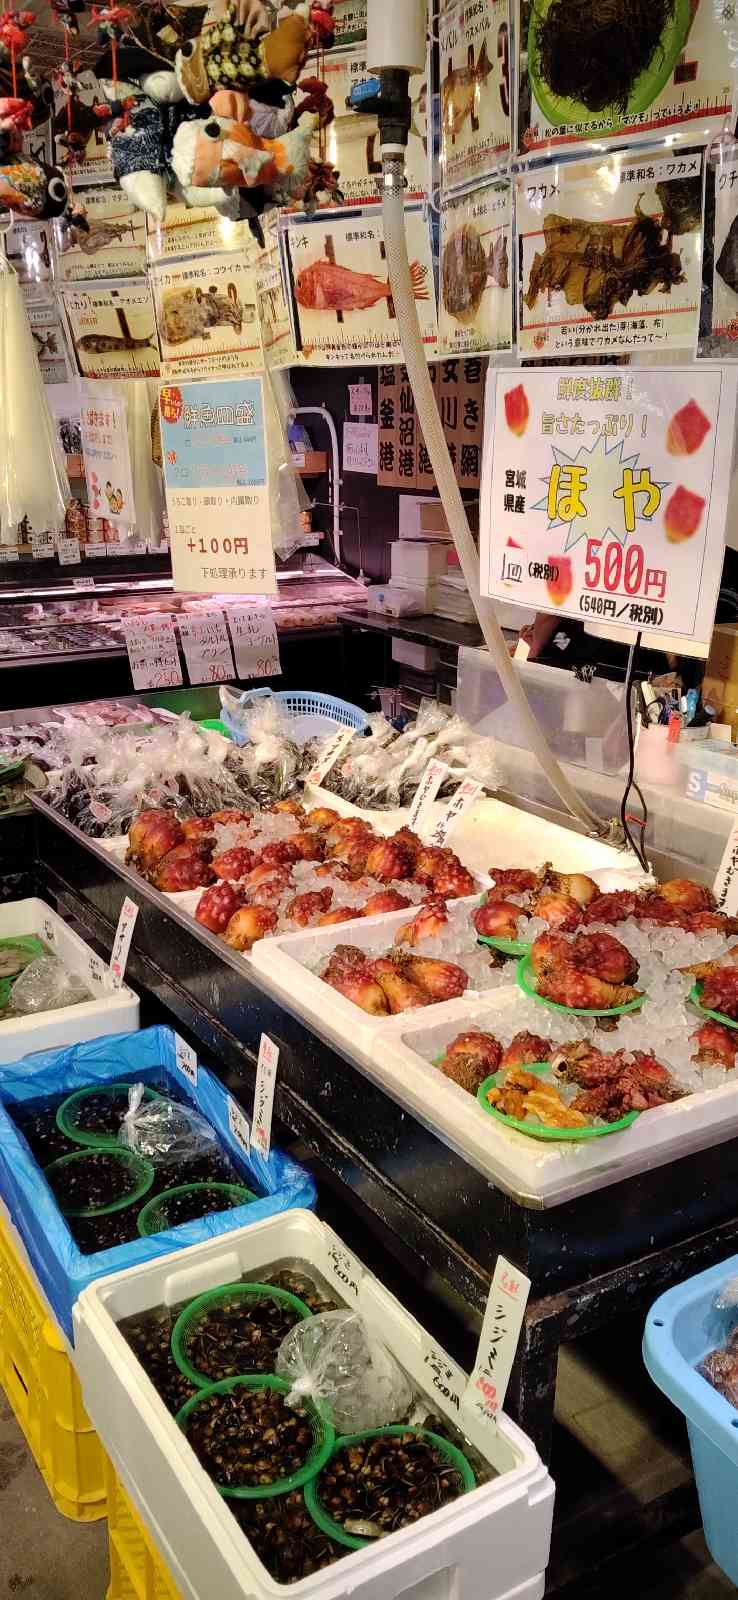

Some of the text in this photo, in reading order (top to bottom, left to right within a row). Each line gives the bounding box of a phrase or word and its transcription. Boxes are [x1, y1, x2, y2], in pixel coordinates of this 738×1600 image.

[541, 411, 648, 438] 旨さたっぷり！
[504, 469, 527, 490] 宮城
[503, 494, 526, 514] 県産
[584, 538, 667, 599] 500円
